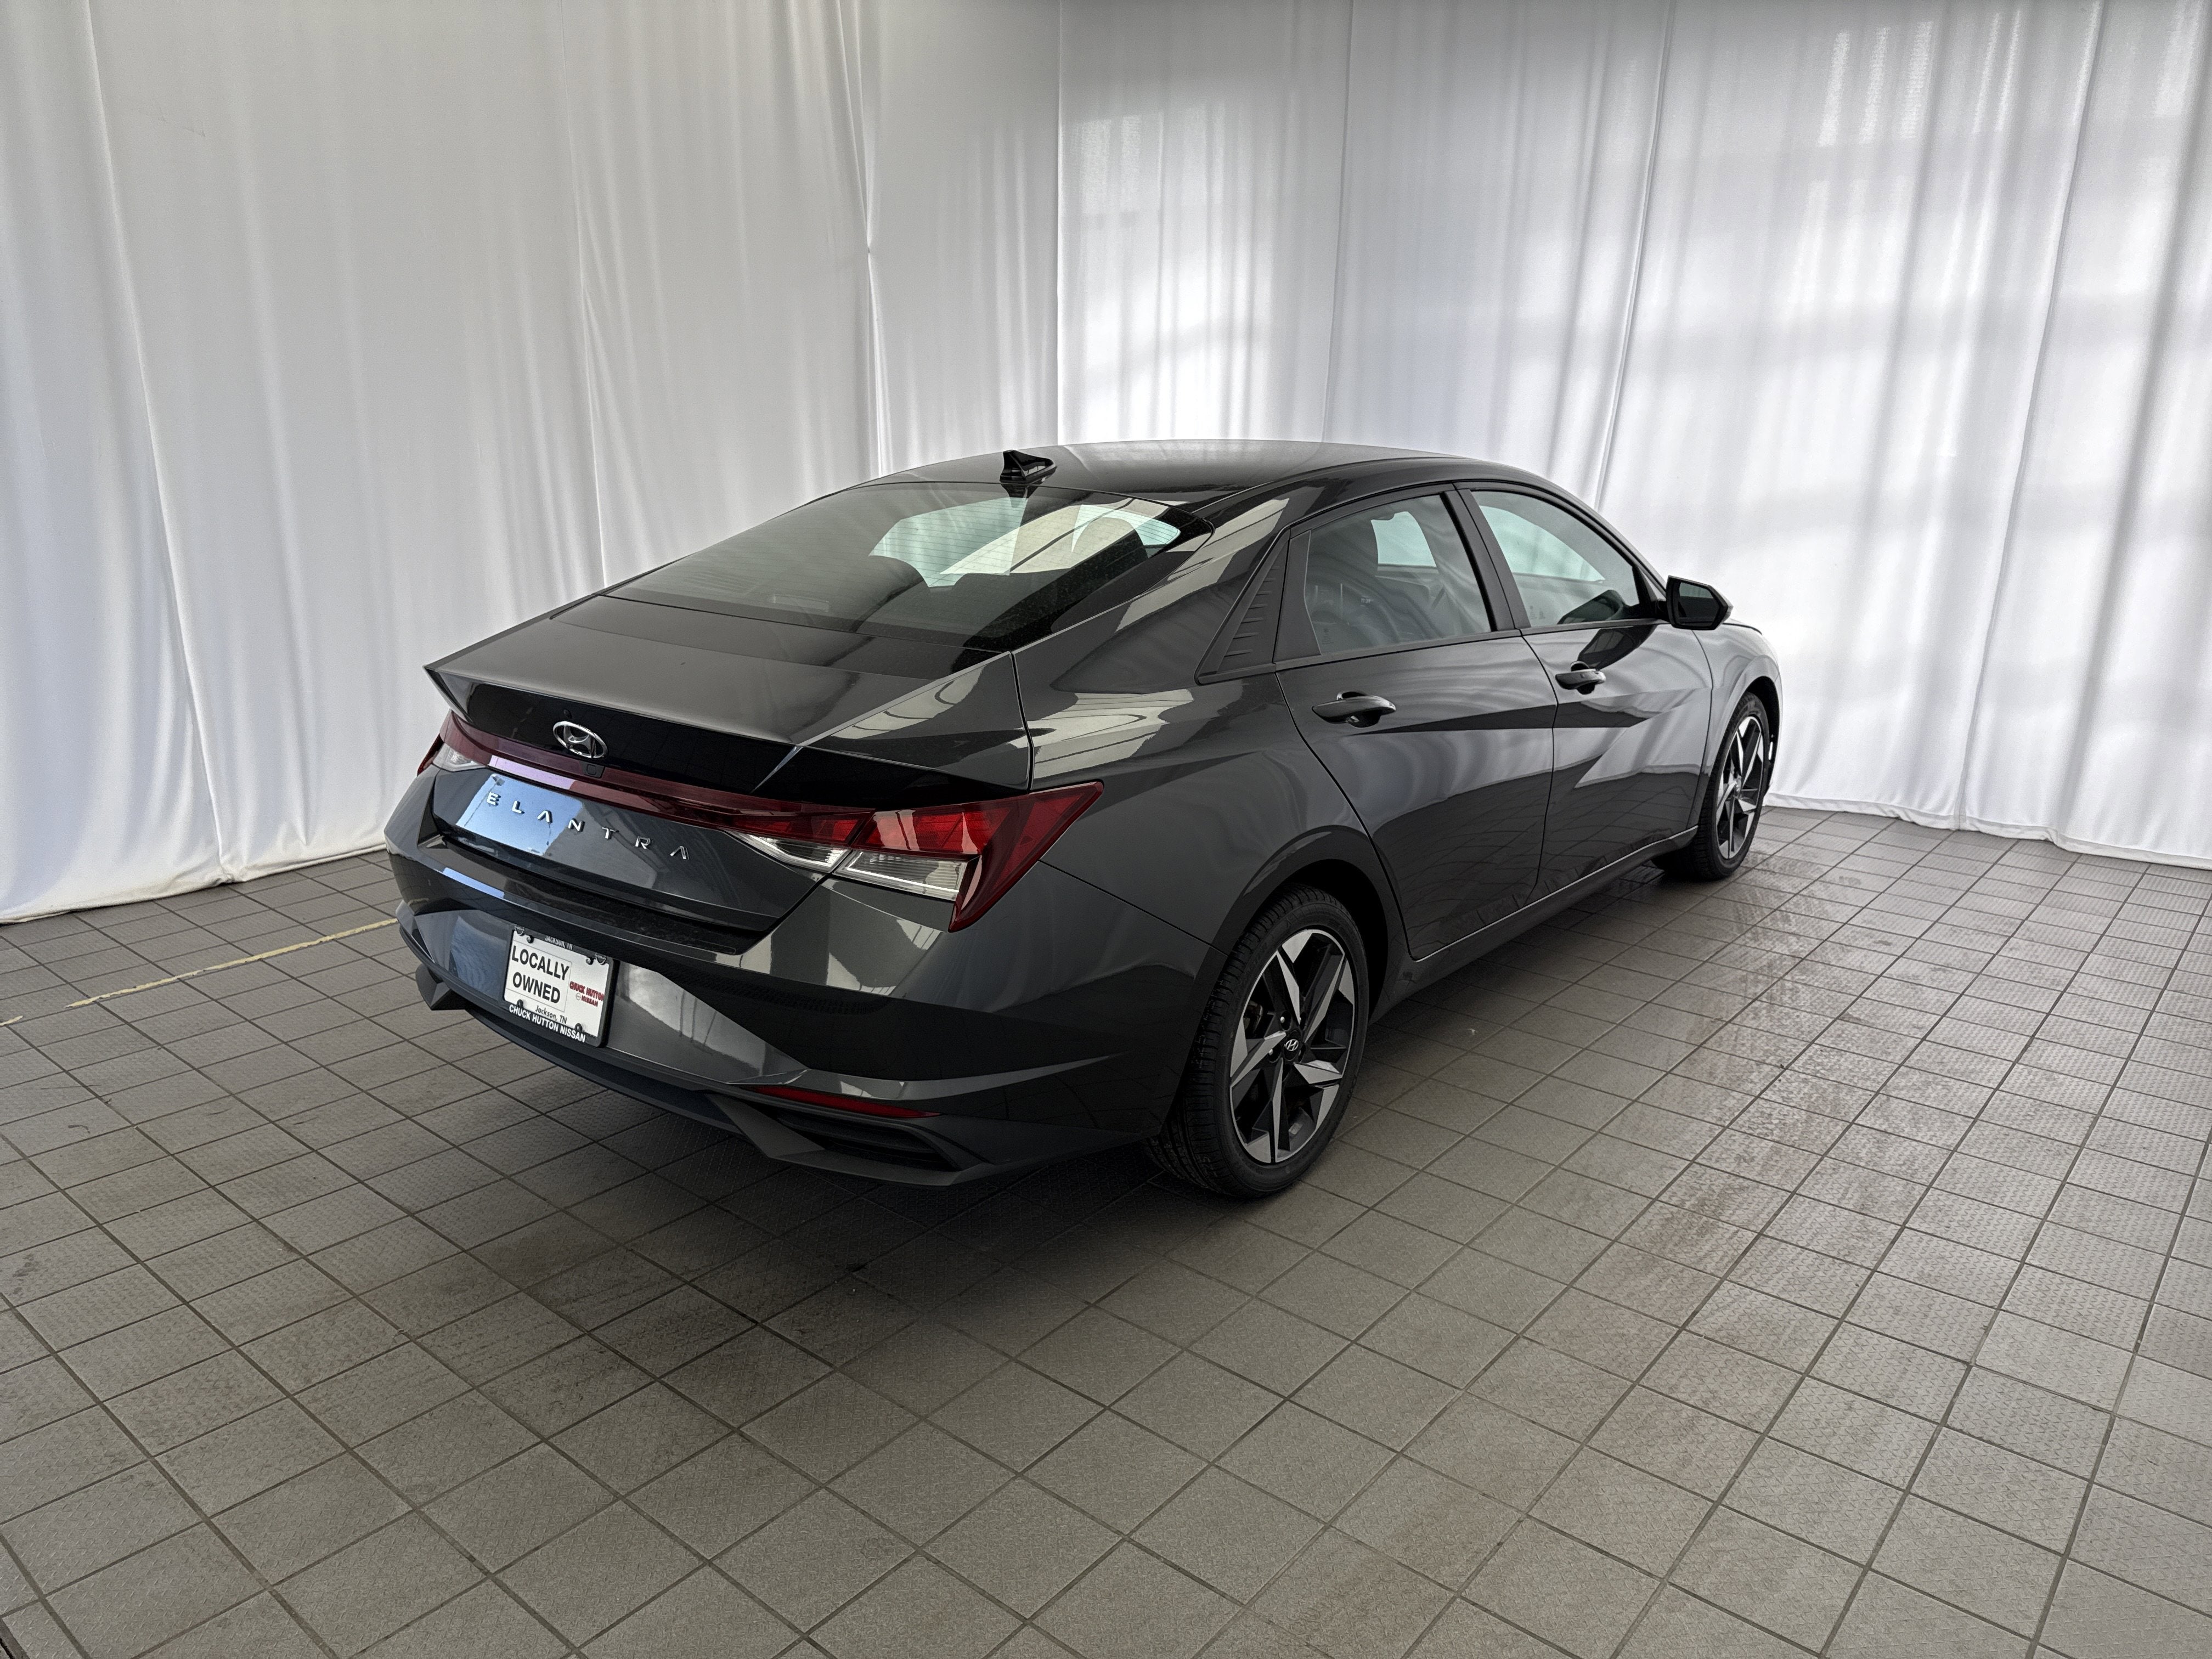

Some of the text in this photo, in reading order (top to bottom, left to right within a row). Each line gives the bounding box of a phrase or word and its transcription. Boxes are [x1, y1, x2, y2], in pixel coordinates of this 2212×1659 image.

[487, 792, 689, 860] ELANTRA
[511, 945, 569, 980] LOCALLY
[512, 972, 560, 1003] OWNED
[569, 981, 605, 1001] CHUCK HUTTON
[581, 995, 598, 1007] NISSAN
[509, 1005, 585, 1042] CHUCK HUTTON NISSAN
[535, 1005, 567, 1024] Jackson, TN
